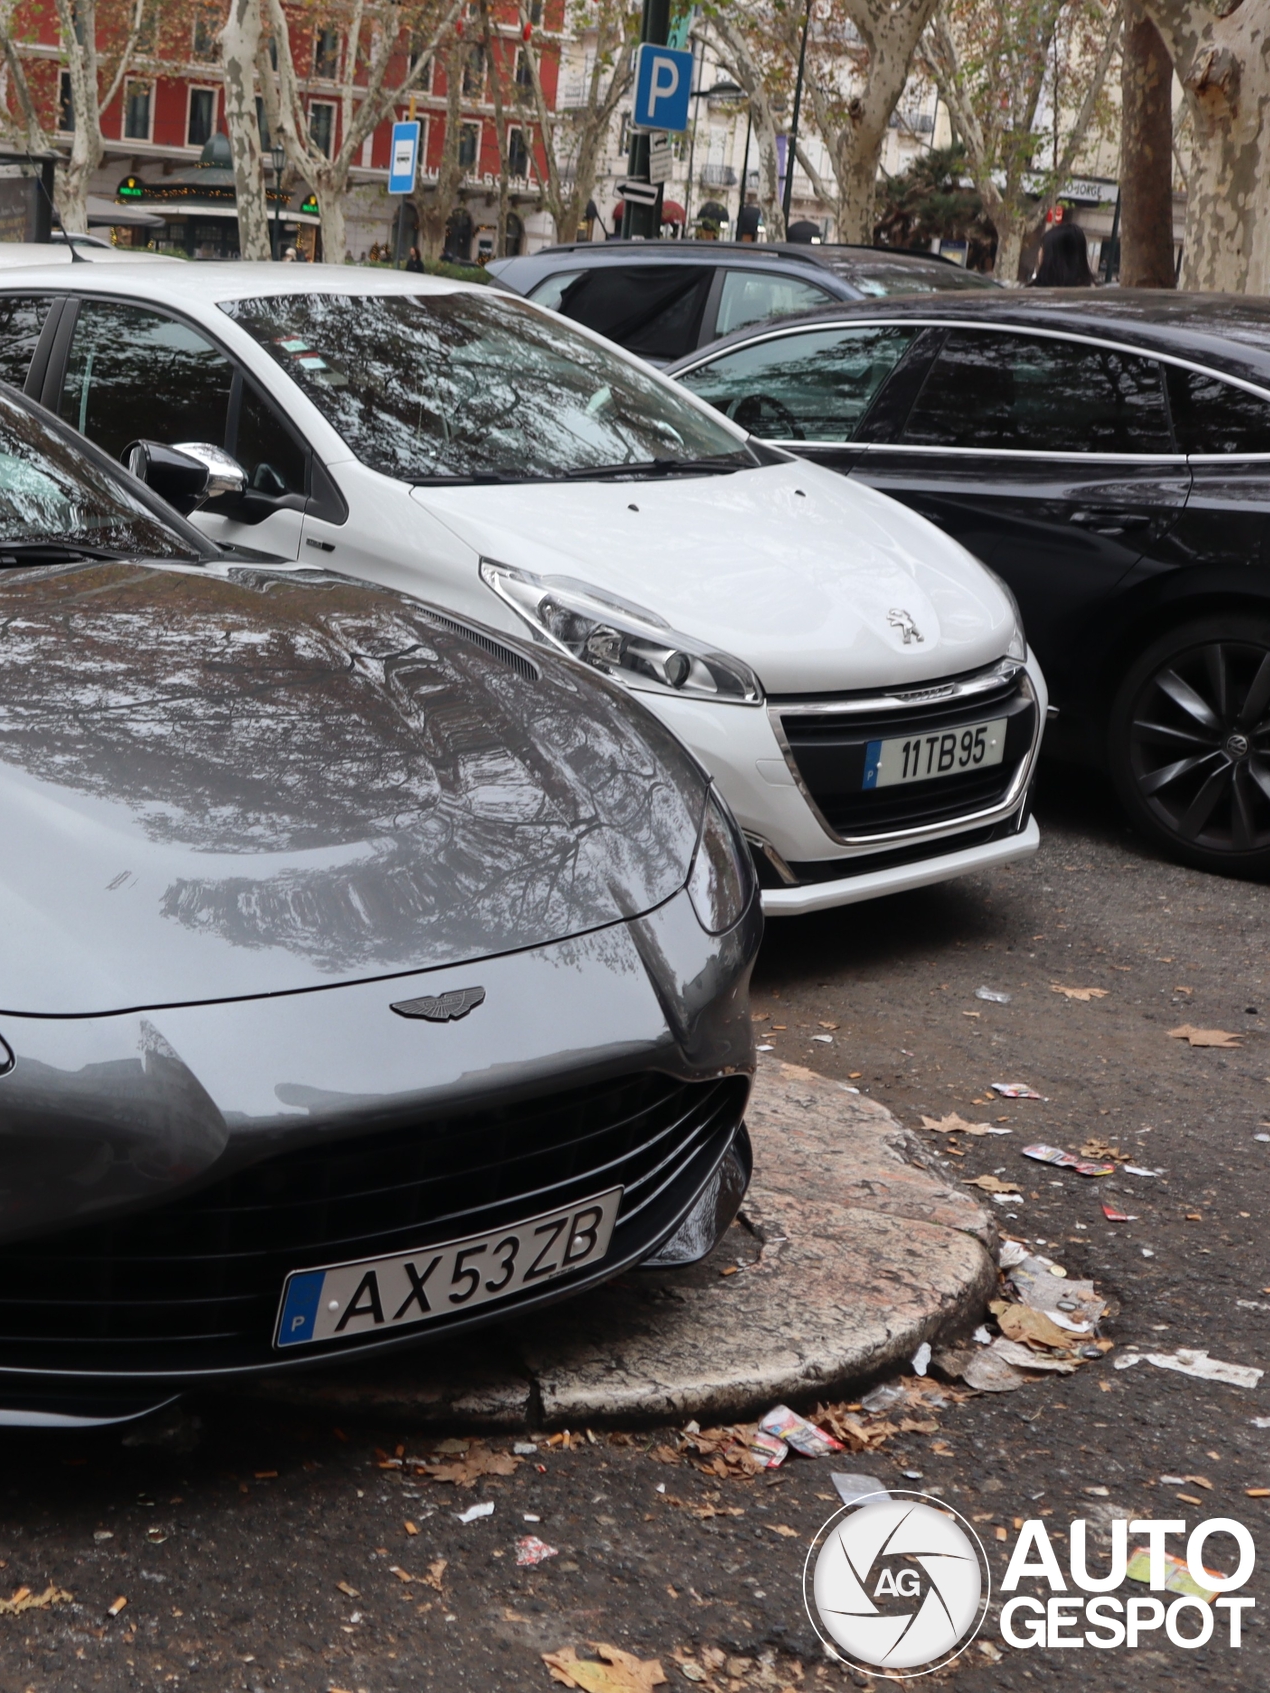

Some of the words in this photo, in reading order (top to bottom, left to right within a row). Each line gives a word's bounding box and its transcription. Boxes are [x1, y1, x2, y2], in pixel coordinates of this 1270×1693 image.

[647, 56, 679, 118] P
[867, 770, 874, 781] P
[901, 726, 988, 779] 11TB95
[334, 1205, 604, 1332] AX53ZB
[290, 1315, 305, 1332] P
